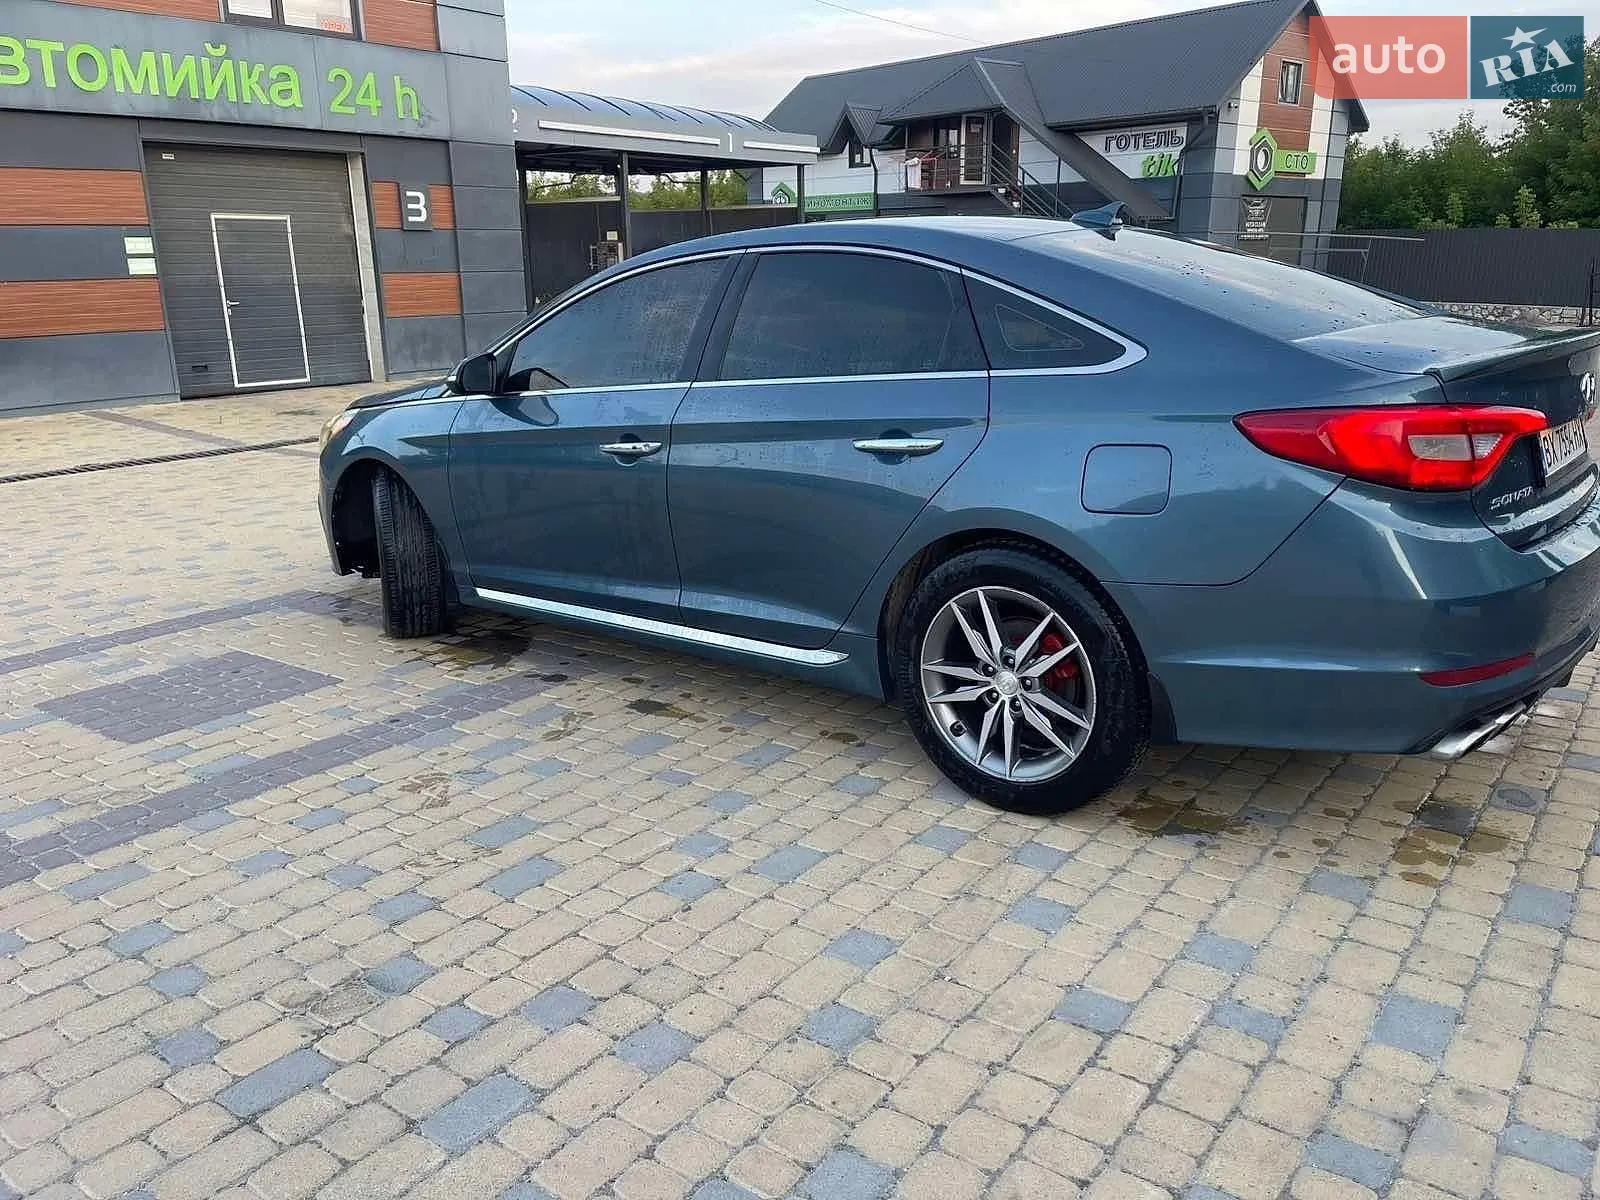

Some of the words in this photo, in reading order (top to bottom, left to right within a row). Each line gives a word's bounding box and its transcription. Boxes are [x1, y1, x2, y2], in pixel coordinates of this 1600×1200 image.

[327, 67, 383, 118] 24
[392, 74, 420, 122] h
[1105, 129, 1185, 153] ГОТЕЛЬ
[1285, 153, 1309, 170] СТО
[405, 190, 428, 222] 3
